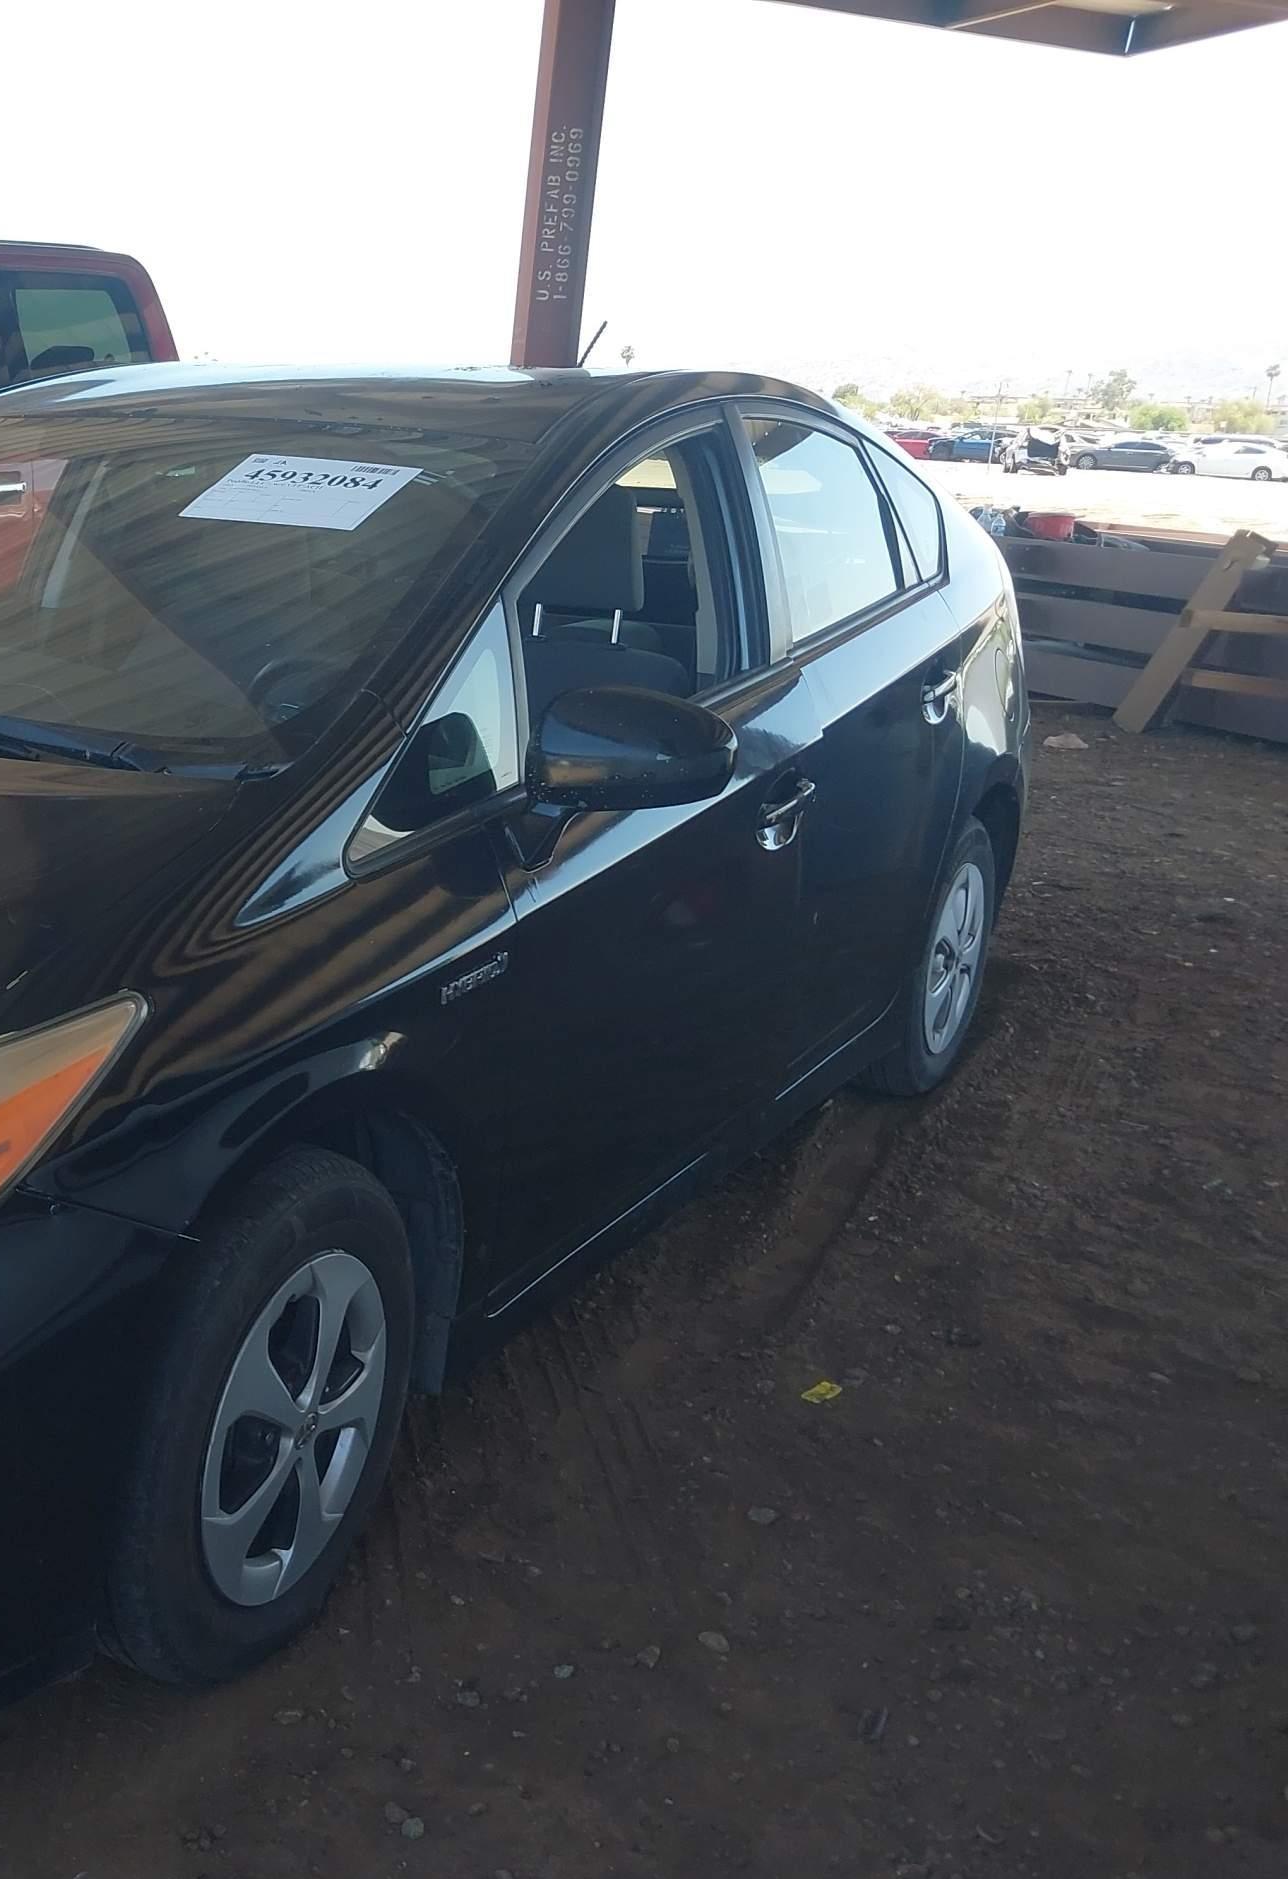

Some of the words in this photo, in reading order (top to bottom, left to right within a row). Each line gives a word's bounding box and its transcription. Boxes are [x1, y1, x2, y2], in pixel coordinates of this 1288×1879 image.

[549, 125, 567, 163] INC.
[541, 174, 561, 252] PREFAB
[552, 127, 584, 300] 1-866-799-0969
[535, 264, 553, 301] U.S.
[244, 468, 383, 491] 45932084
